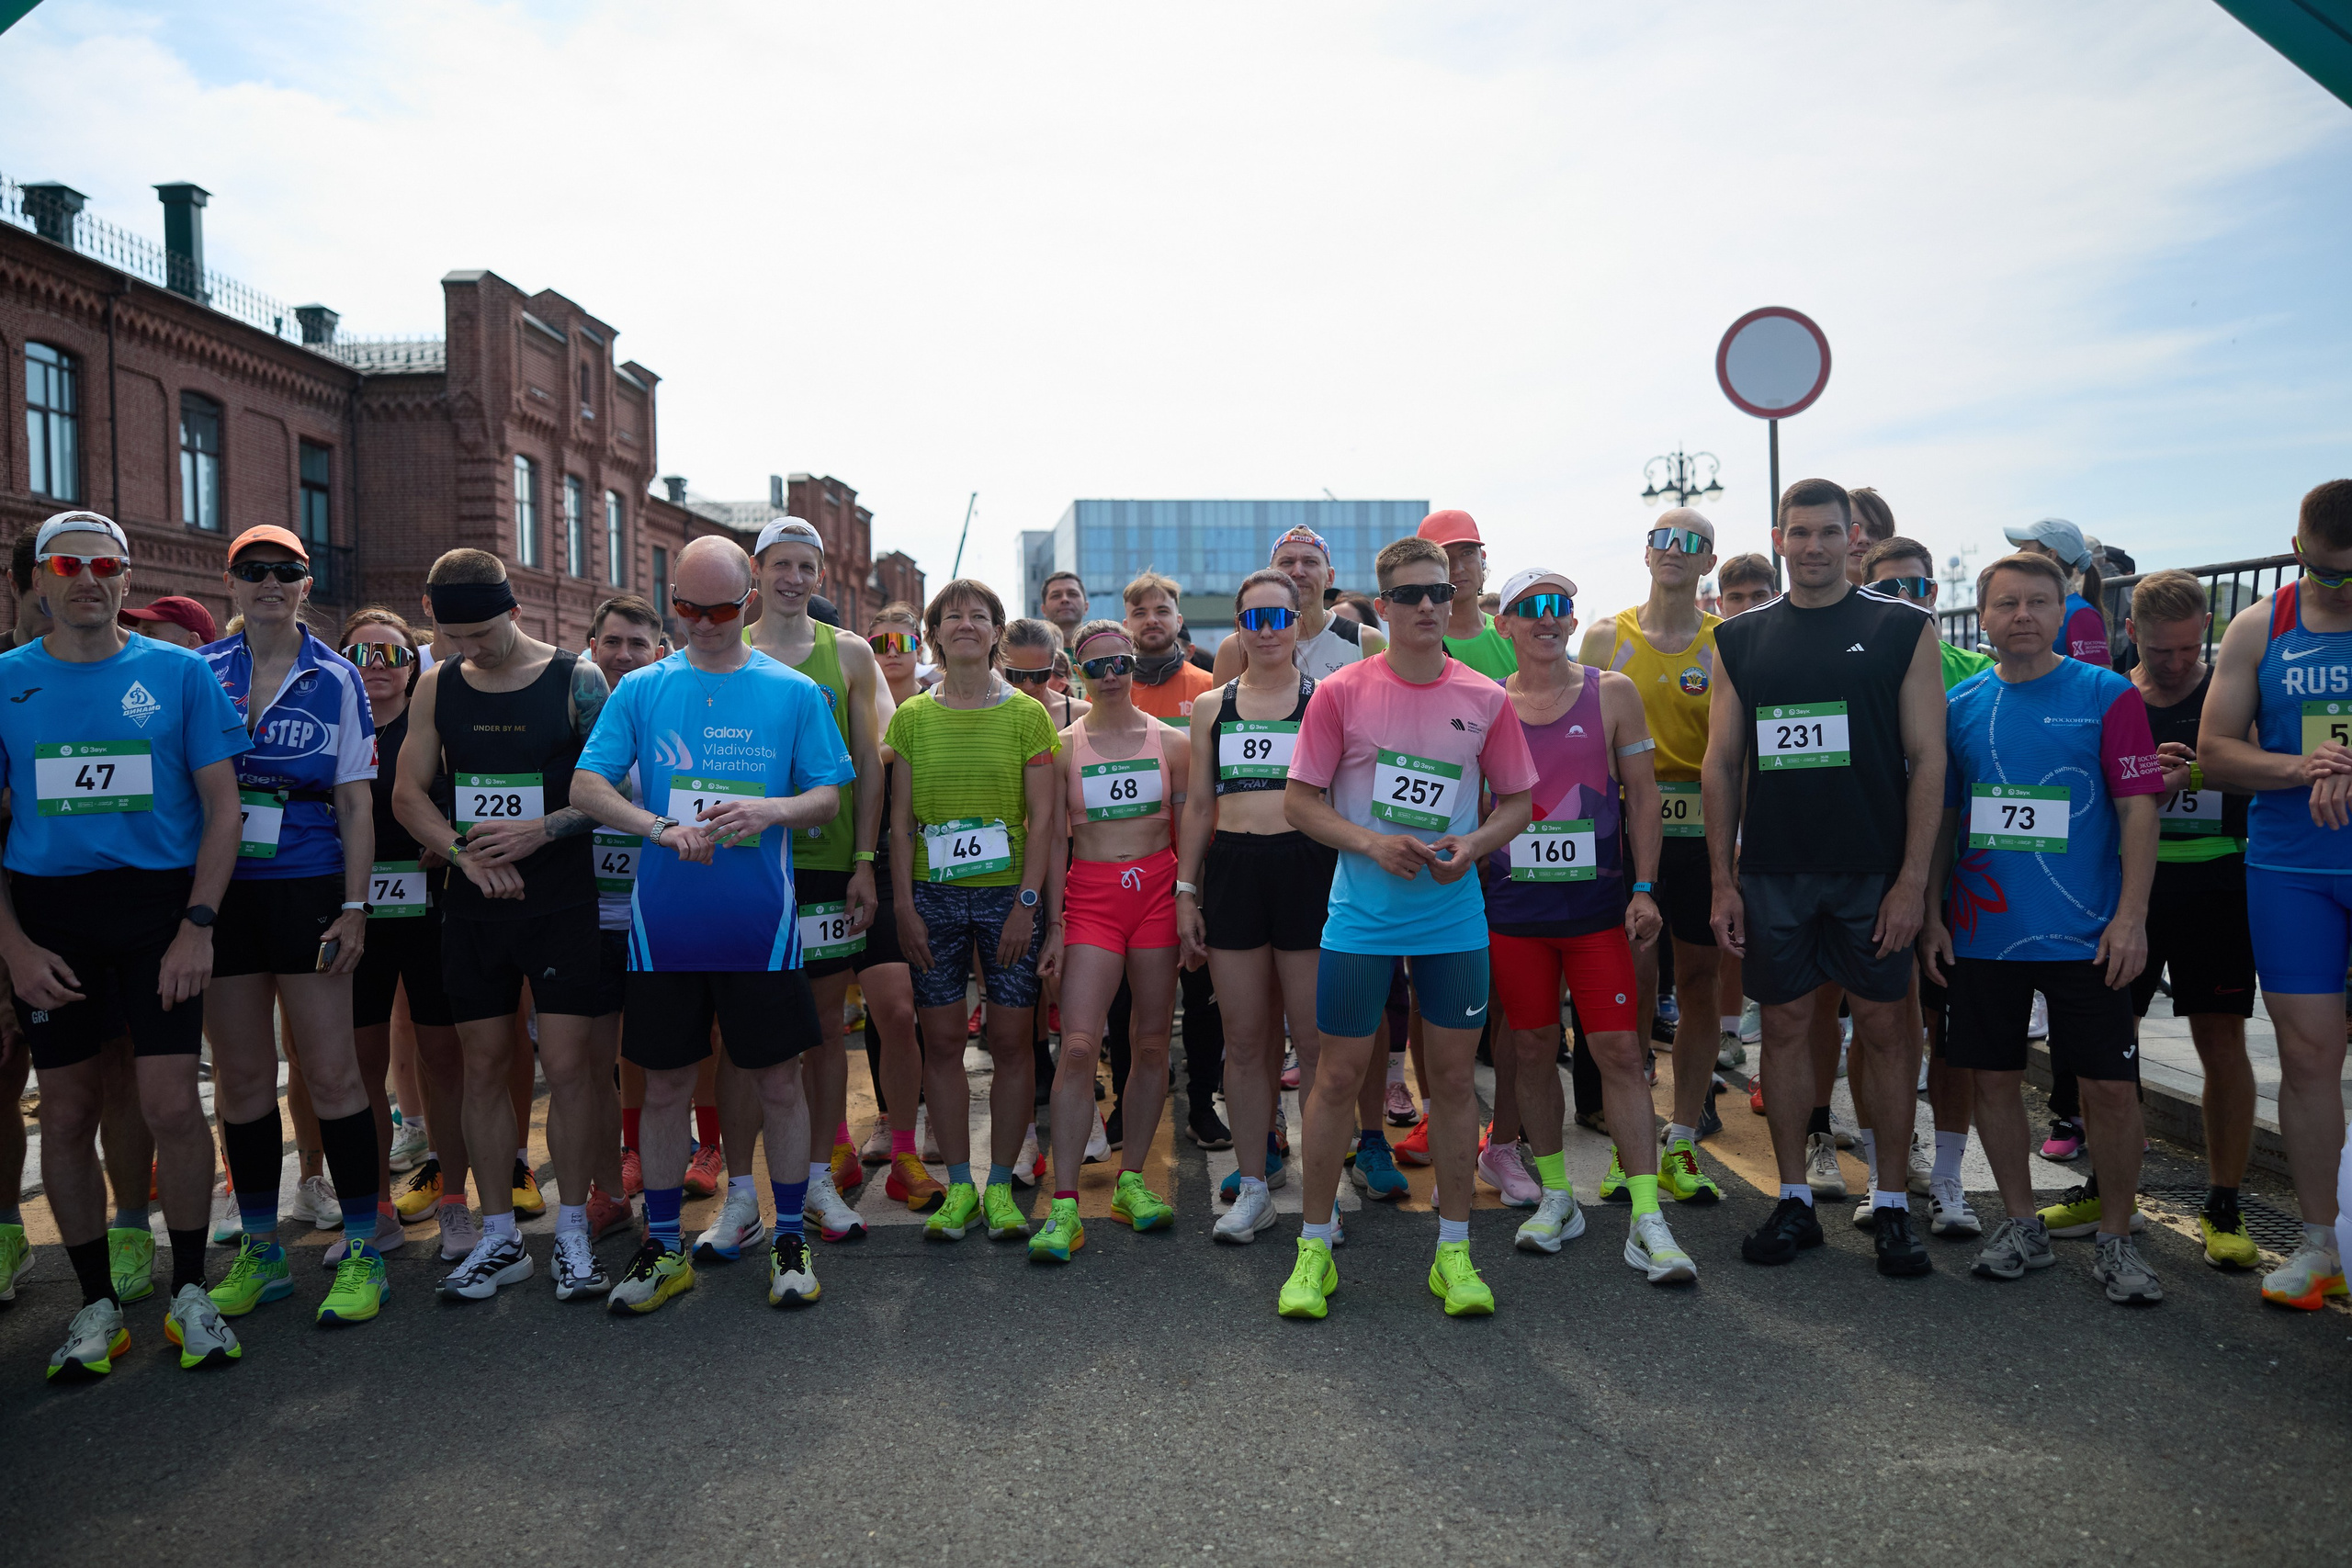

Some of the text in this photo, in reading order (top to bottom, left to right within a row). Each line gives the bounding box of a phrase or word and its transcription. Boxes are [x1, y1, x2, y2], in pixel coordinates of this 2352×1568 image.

[2281, 665, 2352, 695] RUS
[123, 705, 161, 716] ДИНАМО
[264, 719, 314, 749] STEP
[703, 727, 753, 742] Galaxy
[1777, 724, 1823, 749] 231
[2331, 724, 2352, 748] 5
[703, 743, 777, 760] Vladivostok
[1243, 739, 1272, 759] 89
[75, 764, 116, 790] 47
[702, 759, 766, 773] Marathon
[1420, 762, 1435, 771] Звук
[1110, 778, 1137, 800] 68
[1392, 775, 1445, 807] 257
[474, 795, 522, 817] 228
[1661, 799, 1687, 819] 60
[2002, 806, 2035, 829] 73
[953, 836, 981, 858] 46
[1531, 840, 1576, 862] 160
[601, 852, 630, 874] 42
[374, 879, 406, 900] 74
